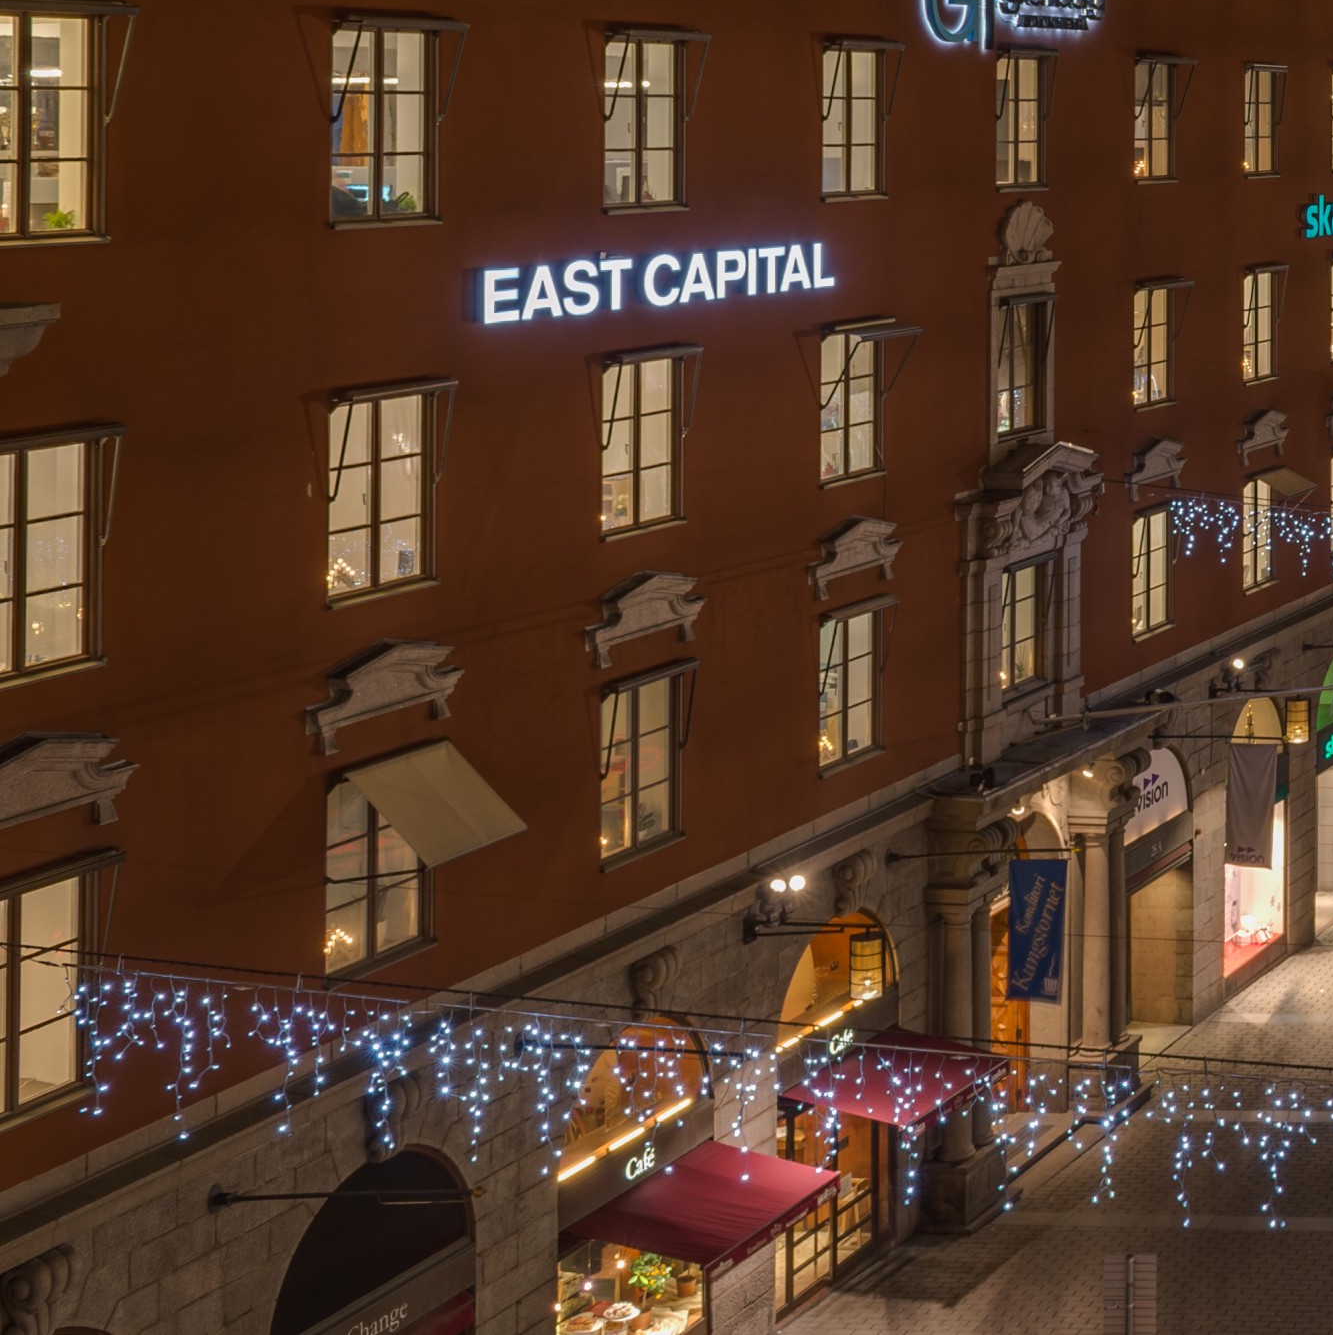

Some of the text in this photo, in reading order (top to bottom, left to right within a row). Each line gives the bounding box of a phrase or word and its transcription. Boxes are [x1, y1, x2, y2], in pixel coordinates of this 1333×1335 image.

[483, 242, 836, 325] EAST CAPITAL
[1136, 780, 1169, 813] vision
[1230, 852, 1265, 865] vision
[1015, 873, 1047, 936] Konditori
[1011, 881, 1065, 992] Kungstornet
[829, 1029, 854, 1055] Café
[625, 1147, 656, 1180] Café
